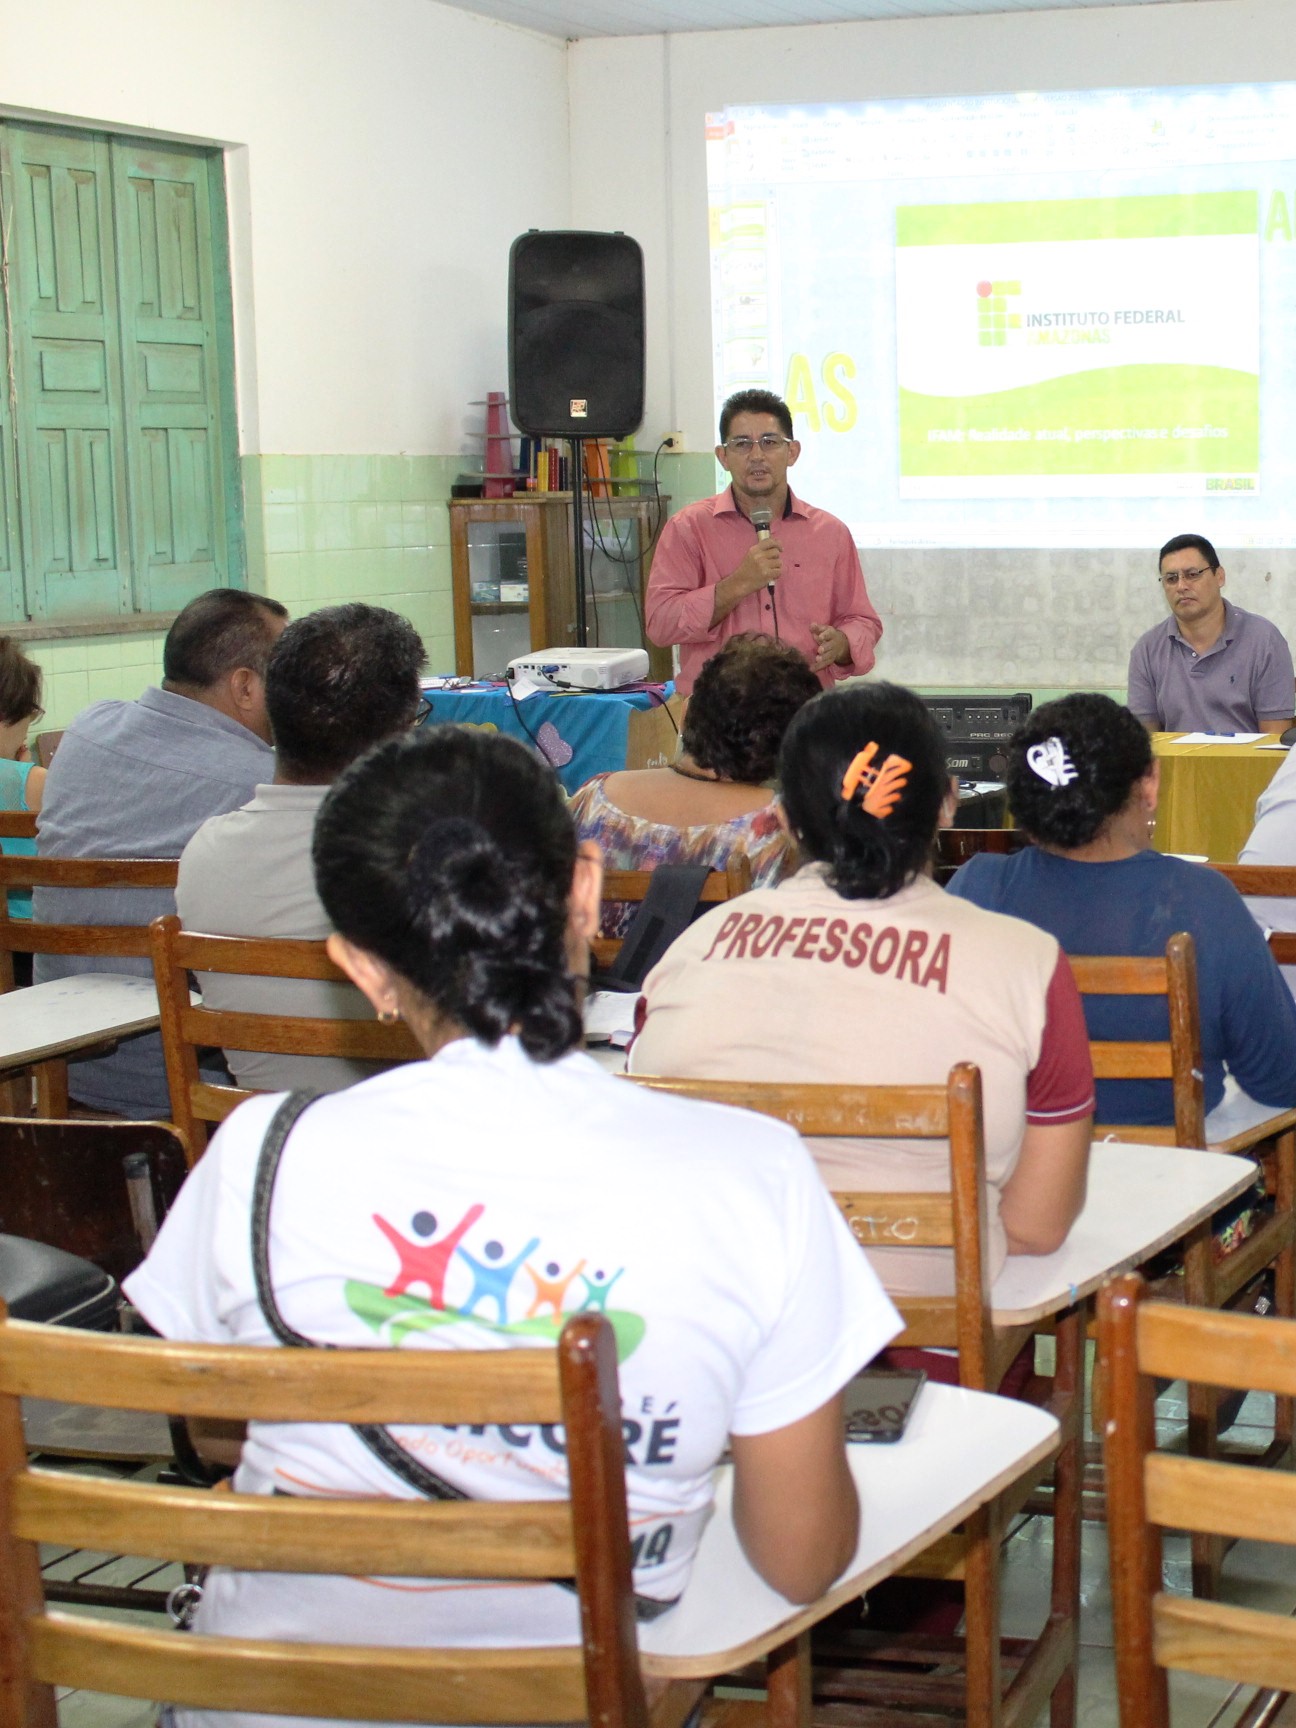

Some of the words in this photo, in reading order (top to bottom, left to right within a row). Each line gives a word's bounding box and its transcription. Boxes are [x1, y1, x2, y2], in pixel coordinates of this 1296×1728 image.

[1026, 310, 1109, 328] INSTITUTO
[1114, 308, 1186, 326] FEDERAL
[780, 351, 859, 433] AS
[967, 427, 1031, 442] Realidade
[1034, 426, 1072, 442] atual,
[1171, 424, 1229, 440] desafios
[1205, 477, 1256, 492] BRASIL
[701, 911, 952, 995] PROFESSORA
